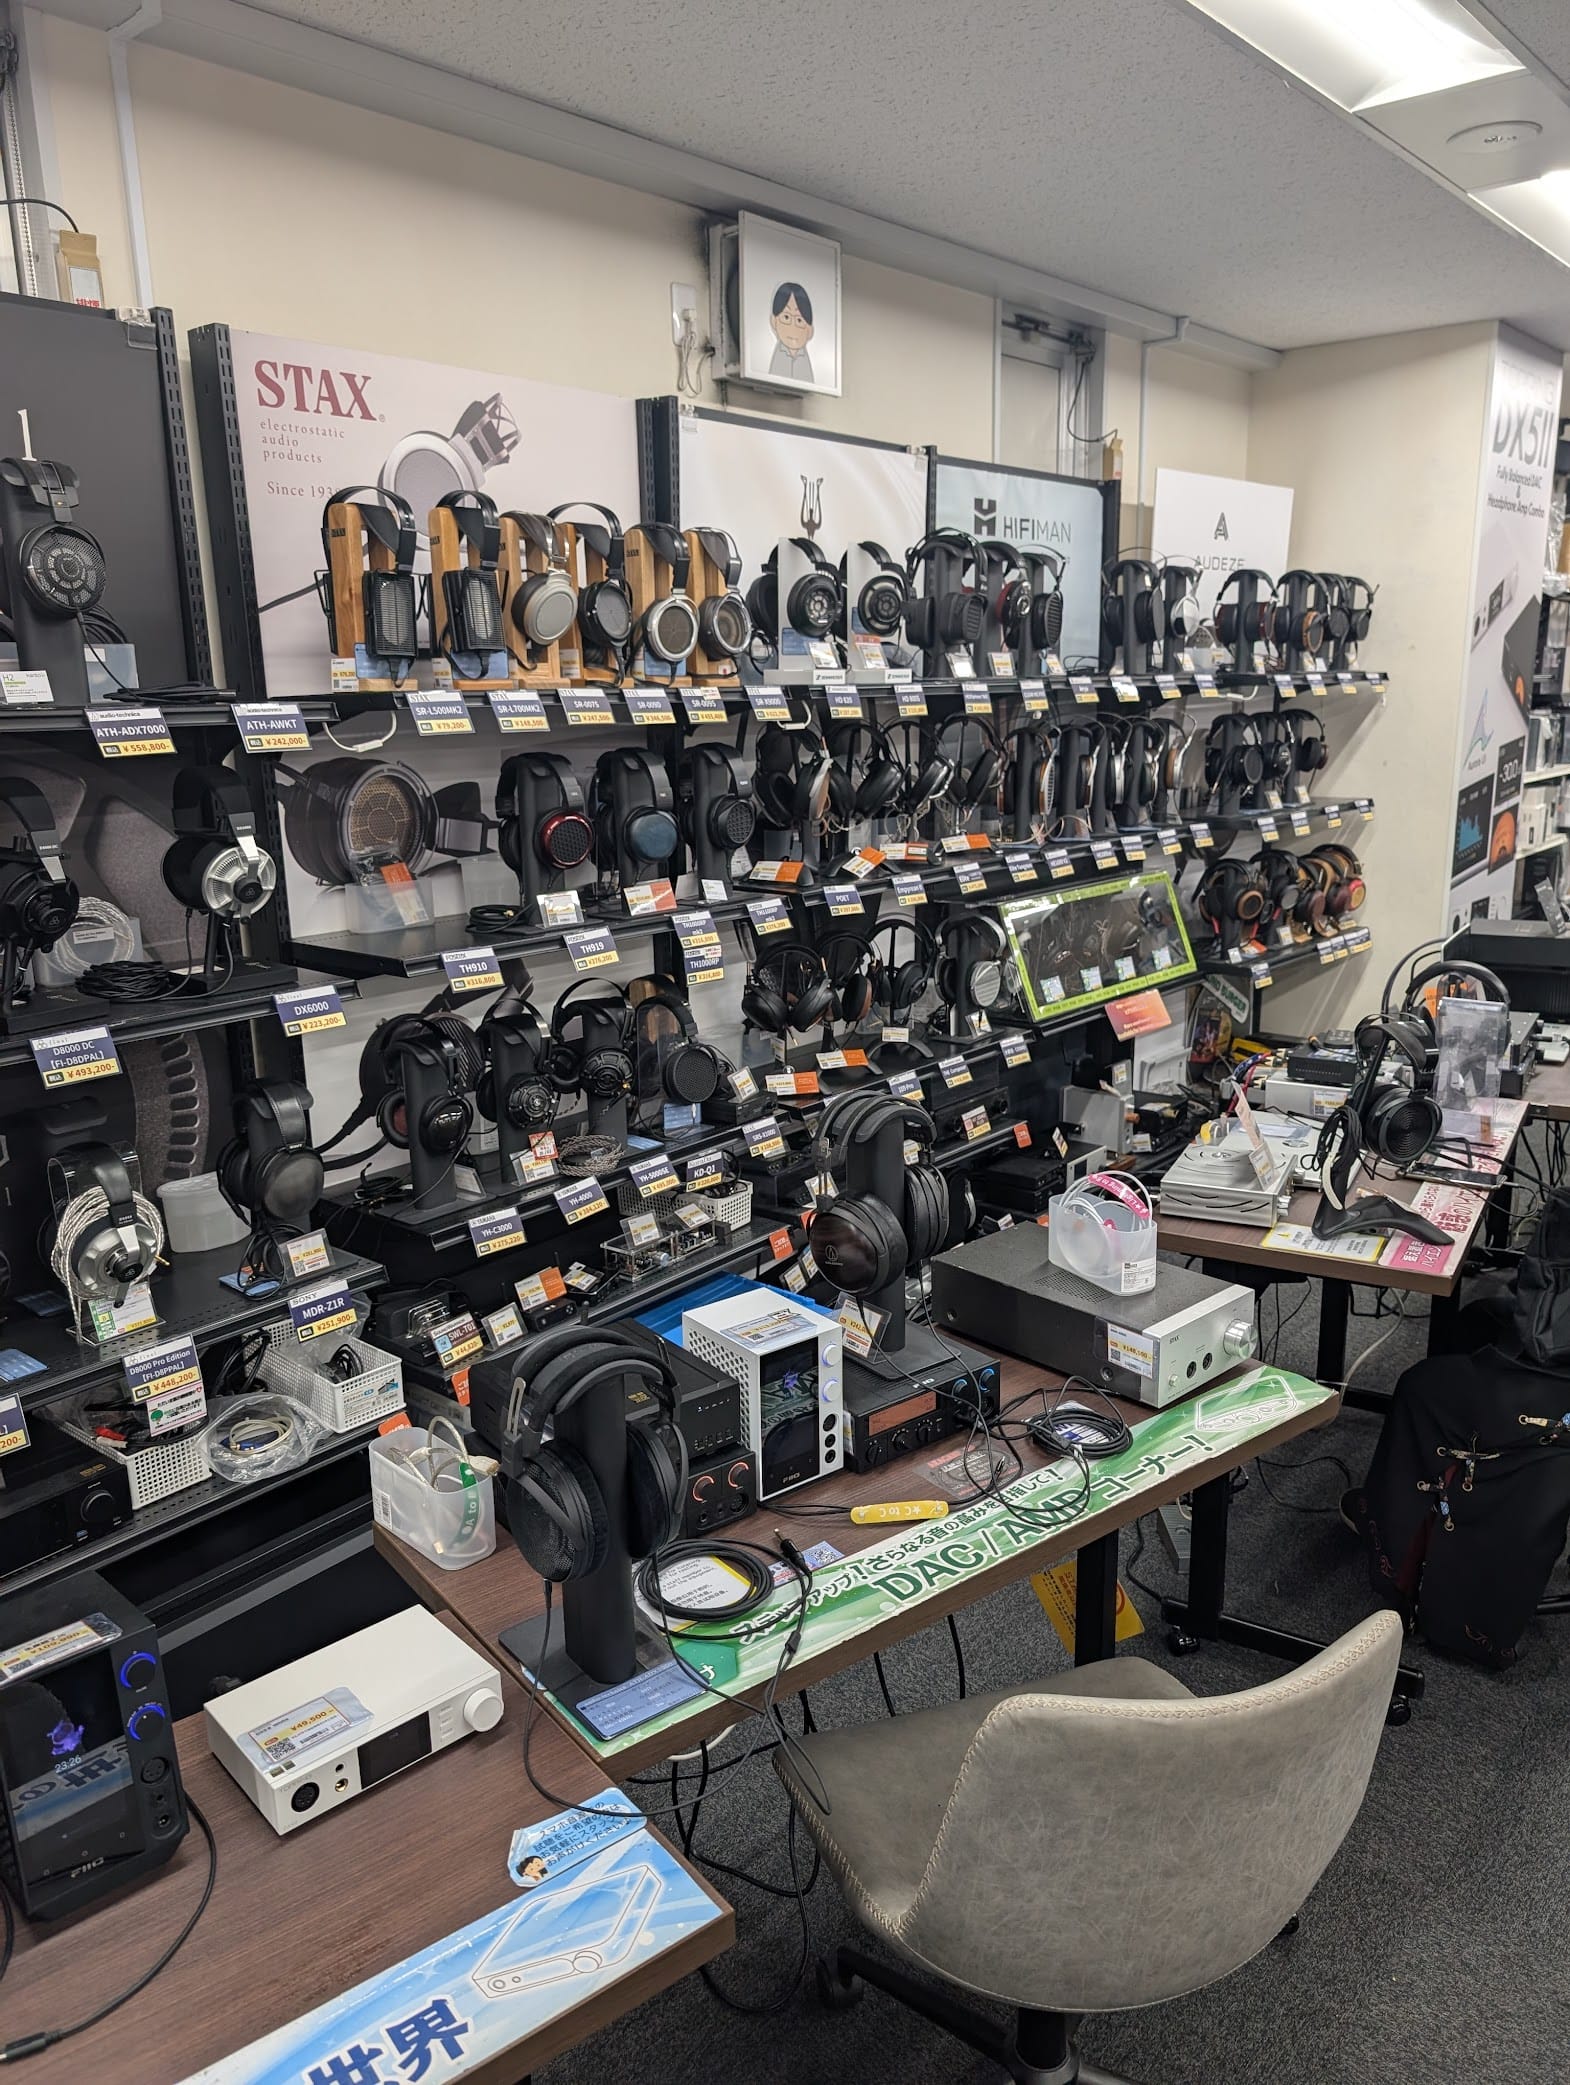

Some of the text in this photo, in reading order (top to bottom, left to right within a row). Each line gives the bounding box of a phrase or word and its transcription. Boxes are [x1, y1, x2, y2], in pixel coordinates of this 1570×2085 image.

[255, 360, 377, 421] STAX
[260, 418, 345, 439] electrostatic
[262, 435, 299, 447] audio
[263, 449, 322, 463] products
[267, 481, 305, 497] Since
[1003, 515, 1071, 543] HIFIMAN
[416, 706, 463, 716] SR-L500MK2
[497, 704, 541, 714] SR-L700MK2
[96, 724, 166, 738] ATH-ADX7000
[246, 719, 297, 731] ATH-AWKT
[580, 942, 605, 955] TH919
[459, 961, 488, 974] TH910
[294, 1001, 329, 1016] DX6000
[53, 1040, 95, 1056] D8000 DC
[66, 1064, 115, 1079] ¥493,200-
[694, 1165, 716, 1179] KD-Q1
[569, 1191, 593, 1206] YH-4000
[481, 1222, 513, 1237] YH-C3000
[302, 1298, 345, 1320] MDR-Z1R
[317, 1314, 354, 1331] ¥251,900-
[449, 1323, 476, 1341] SWL-T01
[129, 1350, 191, 1375] D8000 Pro Edition
[874, 1543, 984, 1600] DAC
[1004, 1489, 1088, 1545] AMP
[54, 1754, 82, 1775] 23:26
[533, 1804, 620, 1853] 試聴をご希望のは
